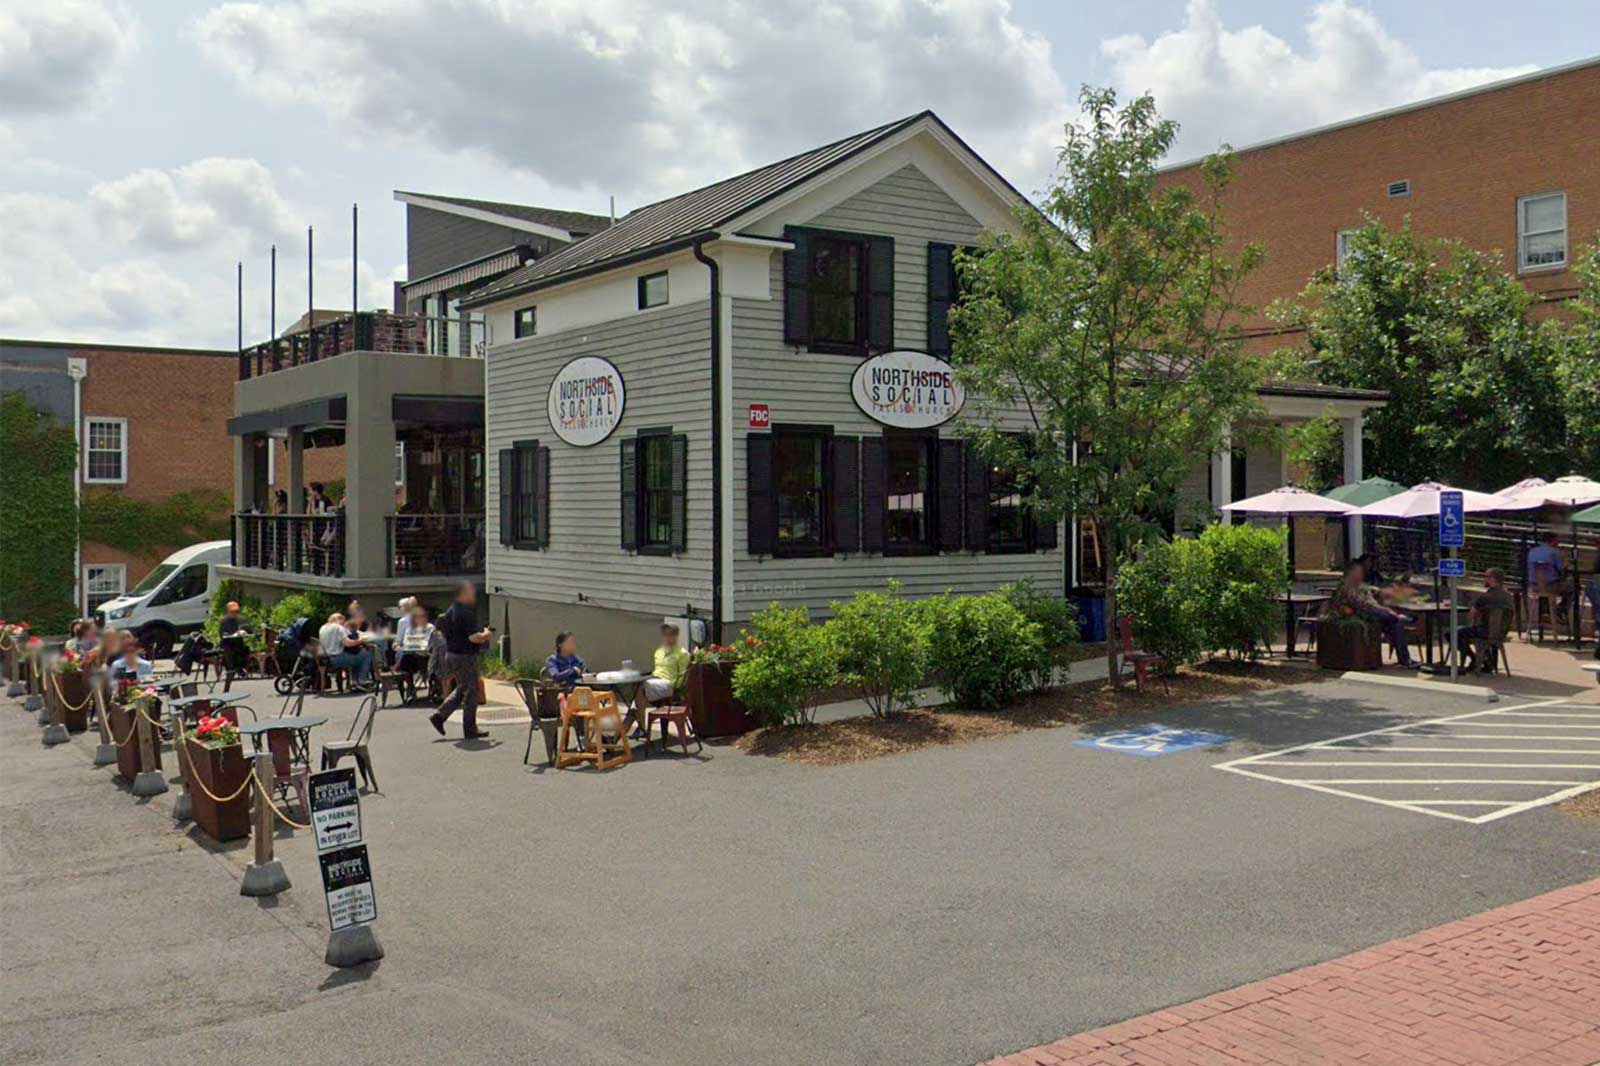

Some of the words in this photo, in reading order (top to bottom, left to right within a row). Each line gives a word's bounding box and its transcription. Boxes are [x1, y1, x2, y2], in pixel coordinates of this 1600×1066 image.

[872, 367, 950, 388] NORTHSIDE
[560, 375, 614, 400] NORTHSIDE
[872, 386, 950, 405] SOCIAL
[560, 397, 613, 418] SOCIAL
[750, 410, 768, 422] FDC
[316, 814, 327, 823] NO
[328, 808, 356, 821] PARKING
[347, 829, 358, 839] LOT
